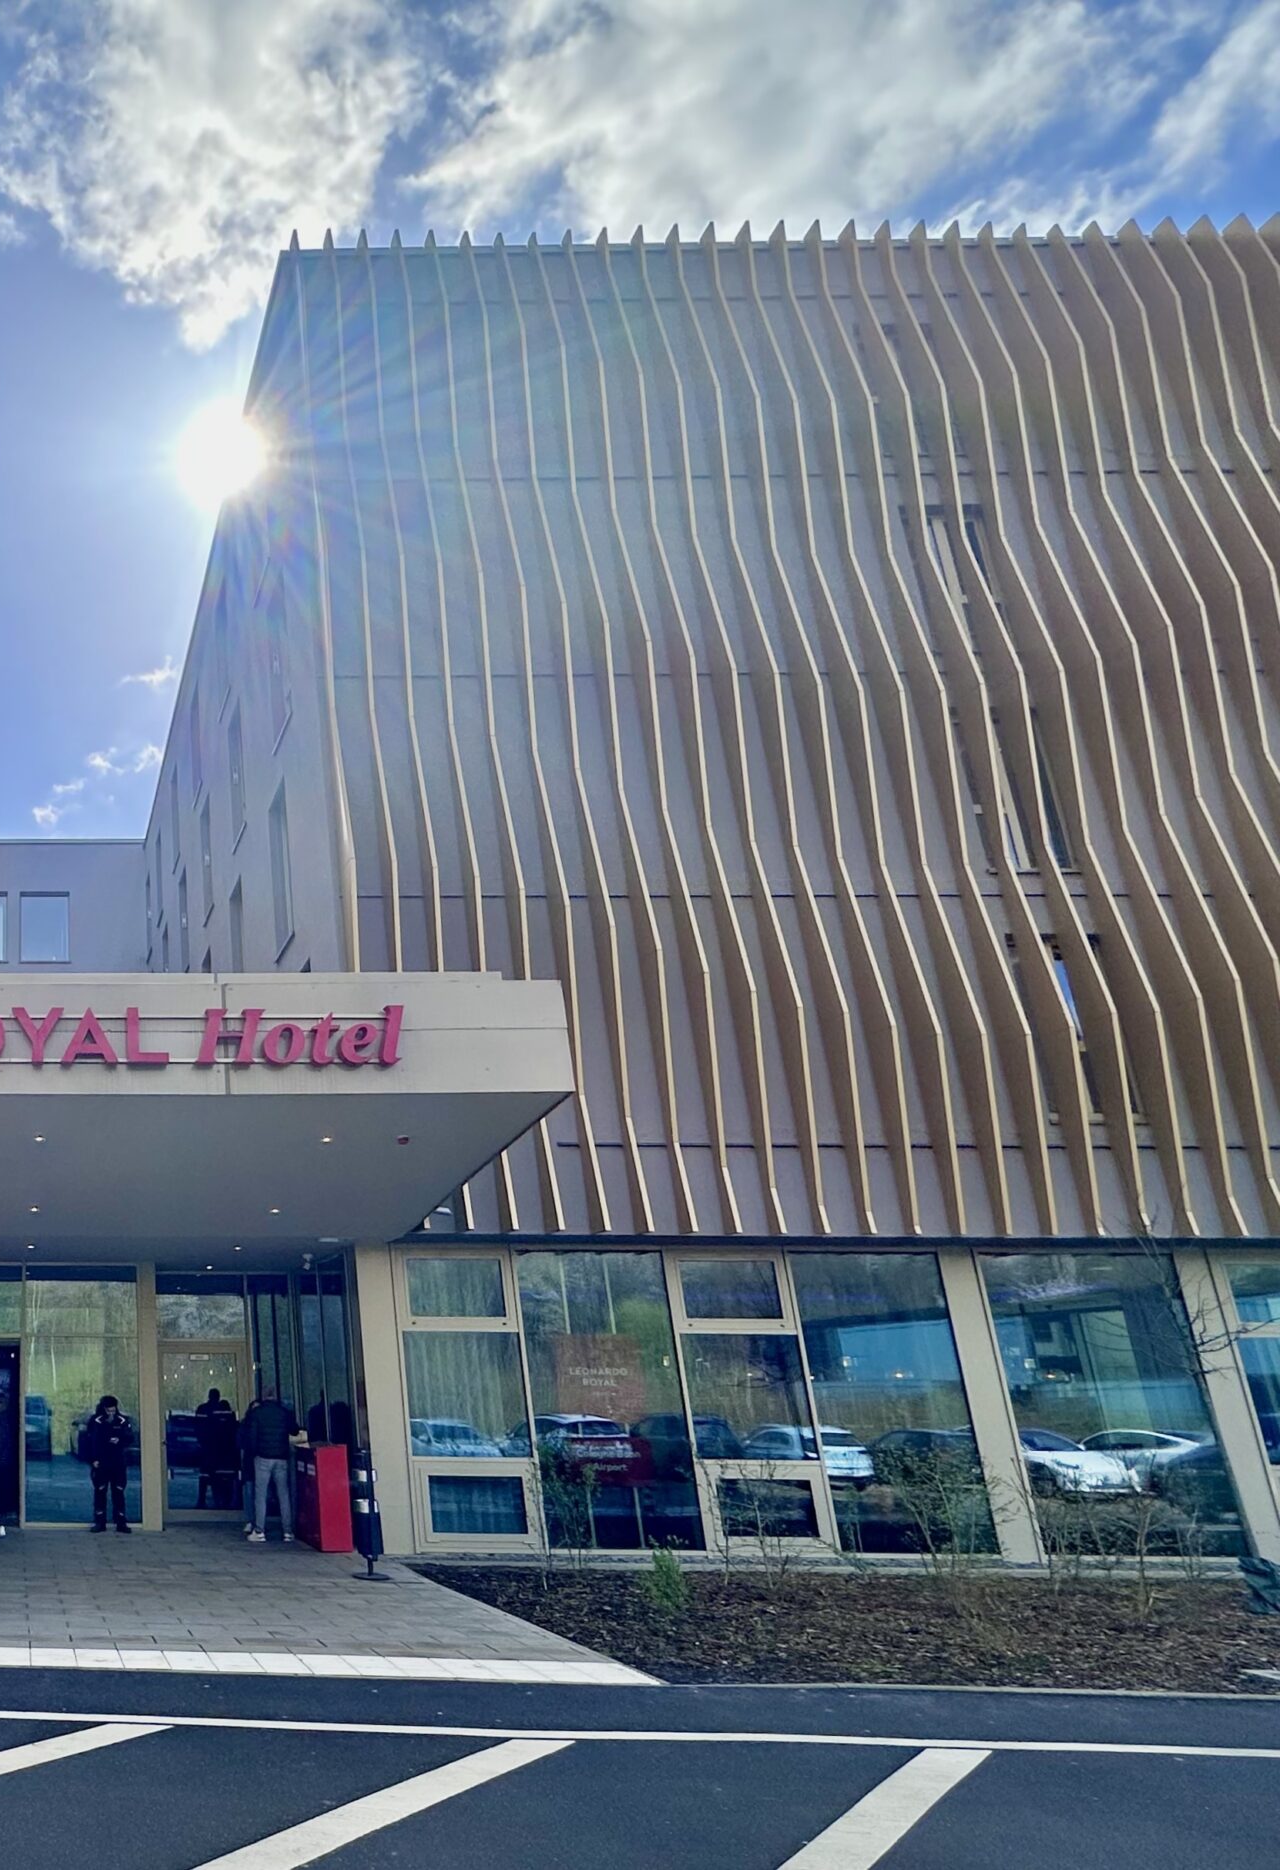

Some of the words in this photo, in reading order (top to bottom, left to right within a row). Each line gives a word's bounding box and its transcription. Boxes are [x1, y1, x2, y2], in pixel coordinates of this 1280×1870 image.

[194, 1004, 404, 1065] Hotel
[569, 1366, 628, 1376] LEONARDO
[582, 1377, 618, 1387] ROYAL
